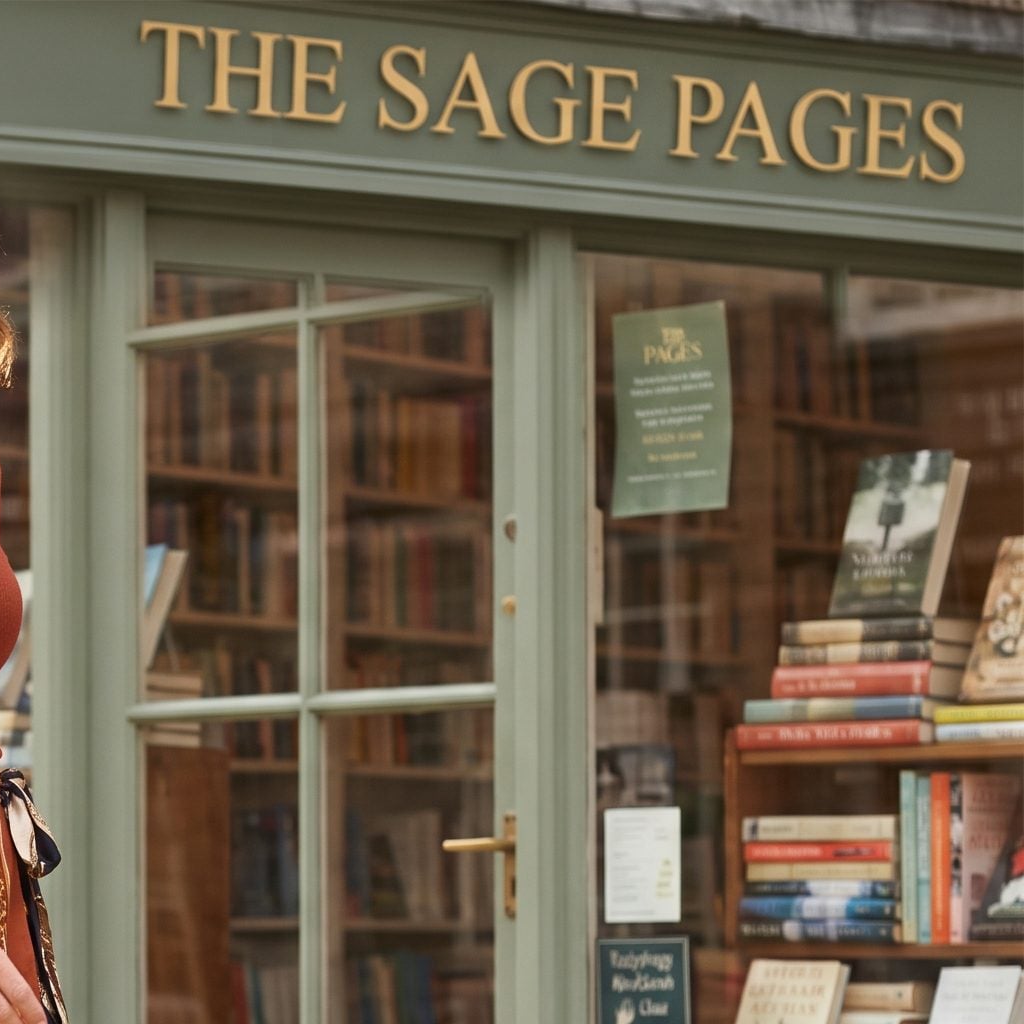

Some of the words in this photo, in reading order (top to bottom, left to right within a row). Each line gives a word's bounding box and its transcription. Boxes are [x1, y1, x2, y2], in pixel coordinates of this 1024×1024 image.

[140, 20, 347, 124] THE
[378, 45, 642, 152] SAGE
[668, 75, 966, 184] PAGES
[643, 340, 704, 366] PAGES
